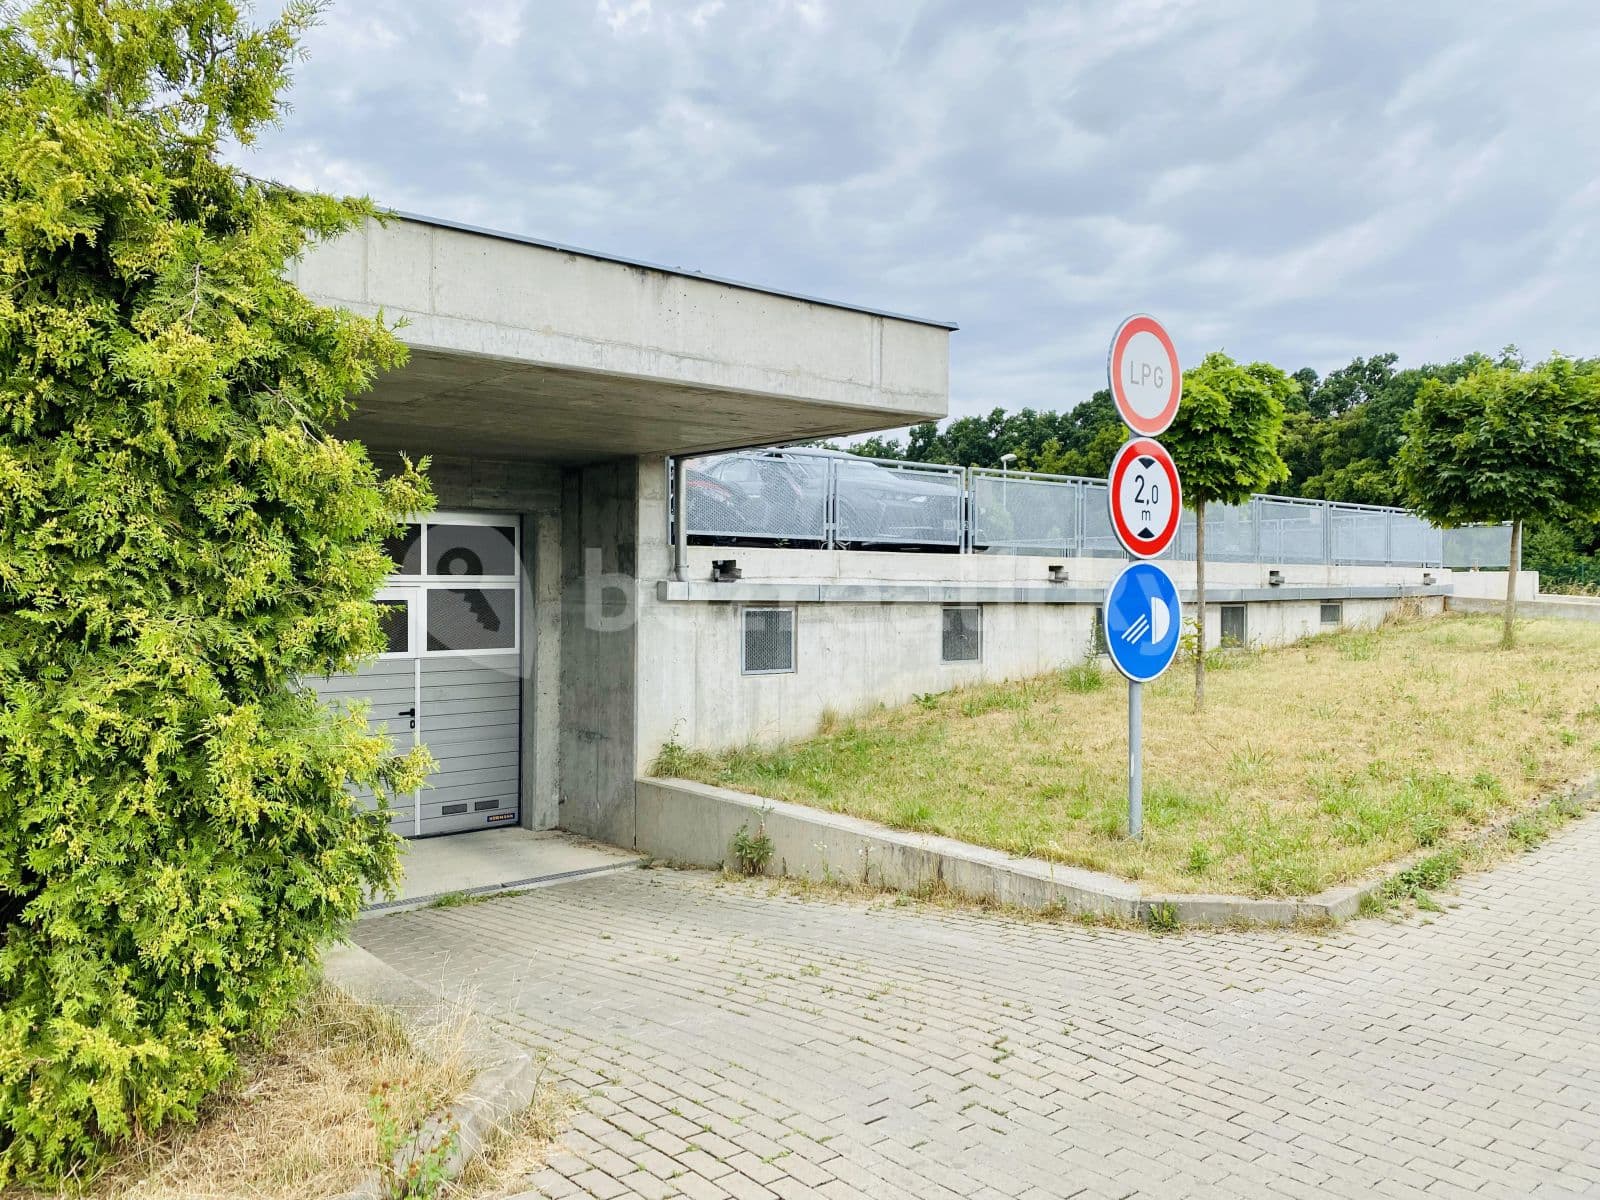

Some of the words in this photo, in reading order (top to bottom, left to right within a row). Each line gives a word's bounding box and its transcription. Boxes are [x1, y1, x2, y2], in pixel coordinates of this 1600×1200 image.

[1130, 360, 1164, 389] LPG
[1134, 474, 1159, 506] 2,0
[1141, 509, 1152, 522] m
